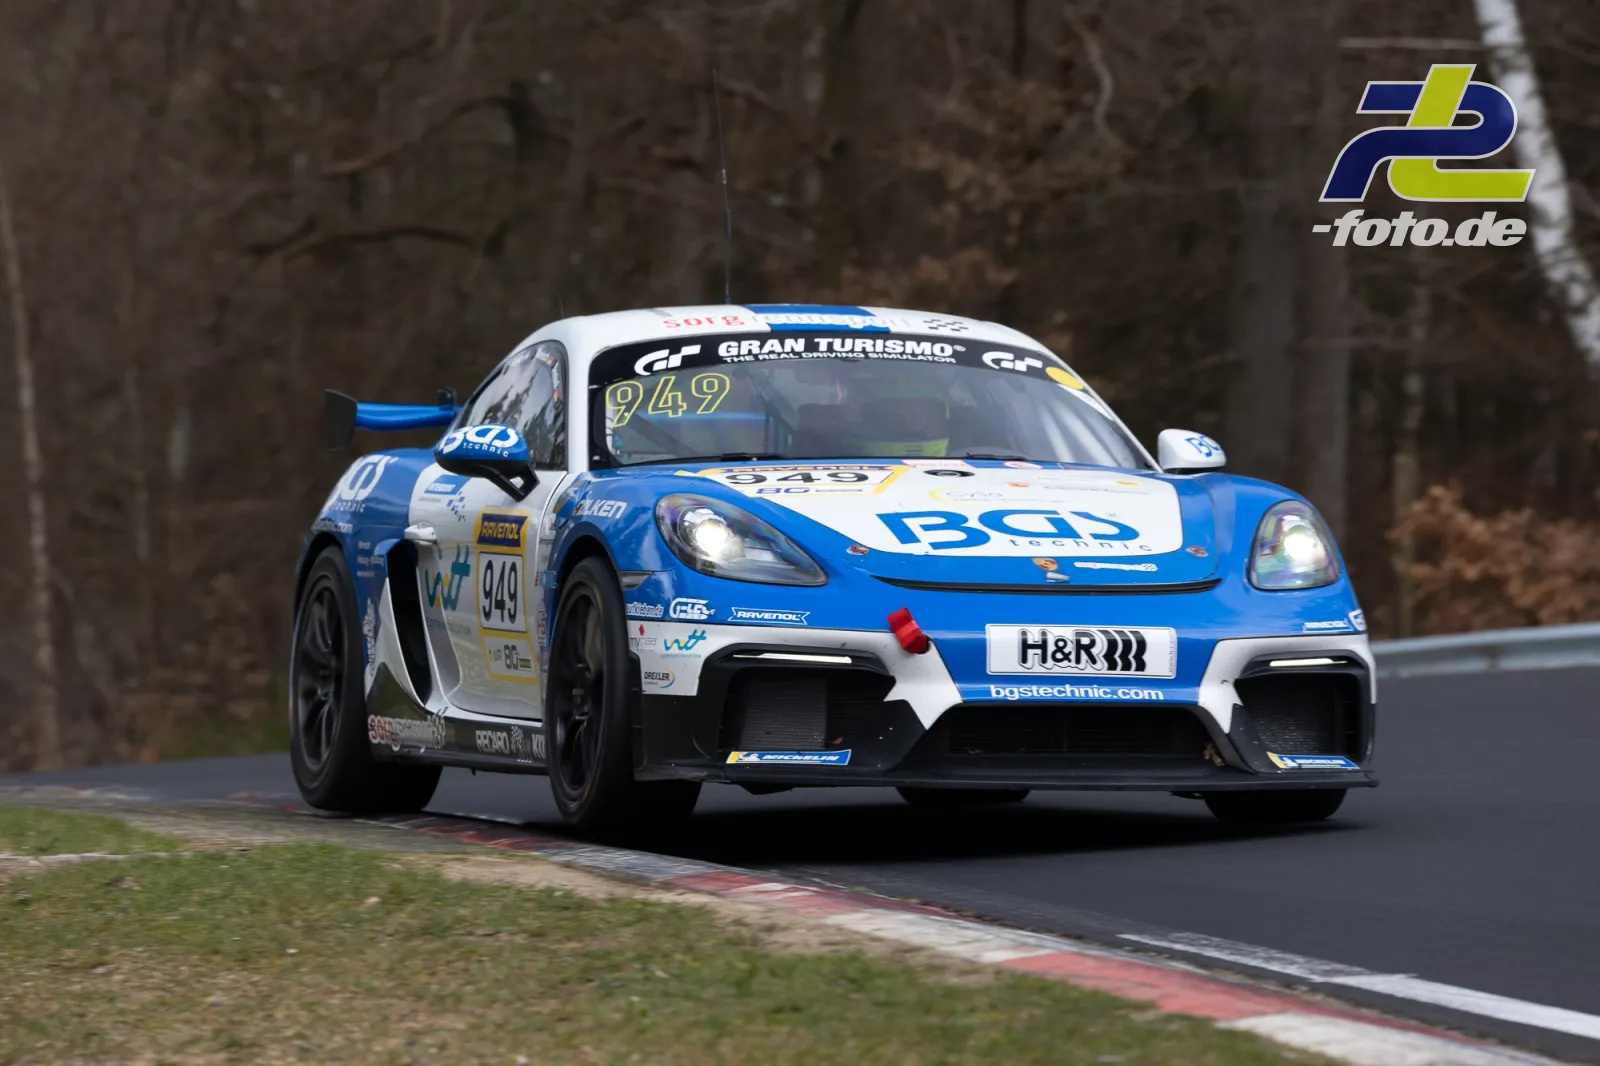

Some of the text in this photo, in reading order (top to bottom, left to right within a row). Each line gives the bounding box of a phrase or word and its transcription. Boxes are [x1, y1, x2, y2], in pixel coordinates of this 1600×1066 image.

[663, 315, 745, 329] sorg
[718, 338, 805, 357] GRAN
[723, 355, 755, 363] THE
[758, 353, 799, 361] REAL
[869, 352, 956, 364] SIMULATOR
[605, 372, 731, 428] 949
[462, 441, 510, 458] technic
[725, 471, 869, 485] 949
[481, 521, 520, 540] RAVENOL
[1009, 537, 1154, 552] technic
[481, 559, 518, 625] 949
[736, 610, 803, 621] RAVENOL
[1019, 628, 1103, 669] H&R
[643, 671, 671, 682] DREXLER
[989, 684, 1164, 701] bgstechnic.com
[475, 730, 510, 752] RECARO
